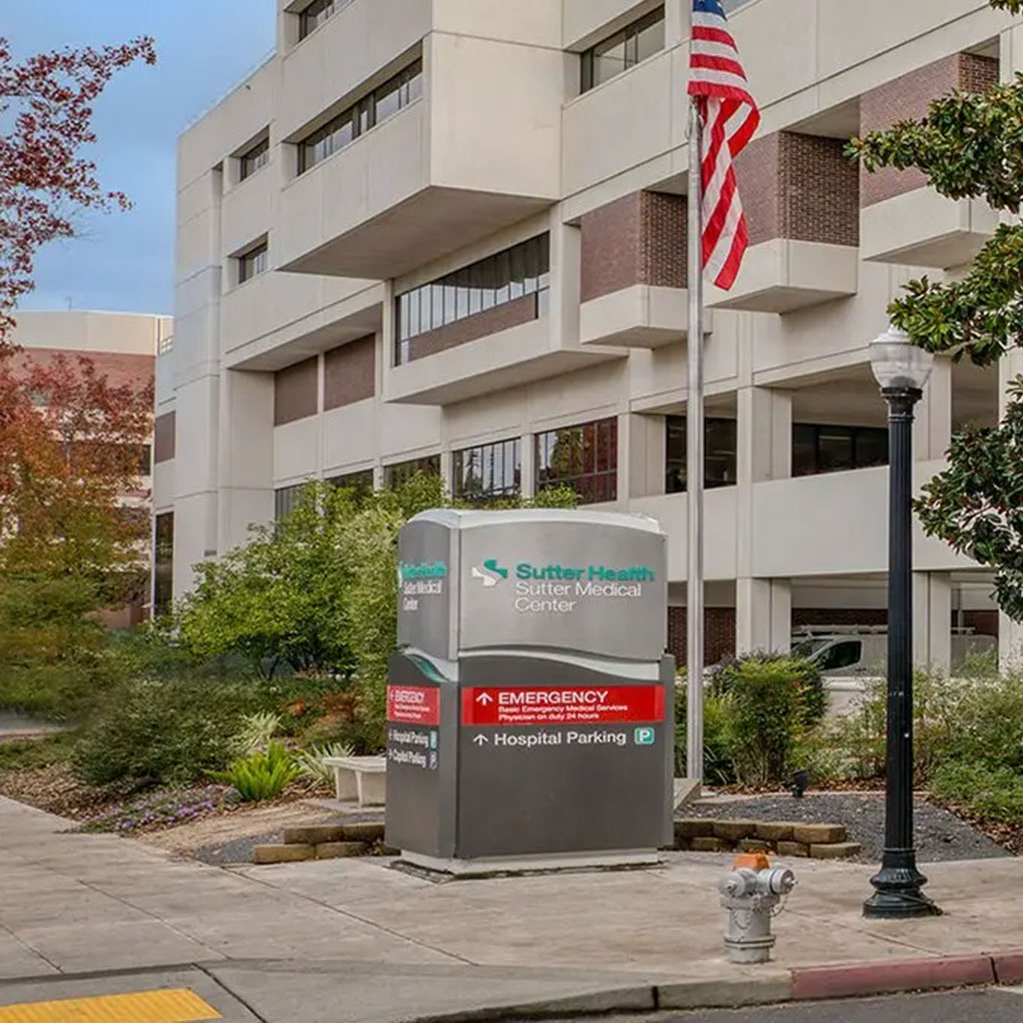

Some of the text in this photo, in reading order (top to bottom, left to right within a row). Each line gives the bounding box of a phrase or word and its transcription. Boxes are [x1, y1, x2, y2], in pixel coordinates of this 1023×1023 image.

[515, 564, 655, 582] Sutter Health
[515, 582, 642, 597] Sutter Medical
[514, 597, 577, 613] Center
[498, 691, 608, 704] EMERGENCY
[521, 705, 564, 714] Emergency
[566, 704, 595, 712] Medical
[597, 704, 628, 712] Services
[498, 713, 536, 722] Physician
[549, 712, 565, 721] duty
[566, 712, 576, 720] 24
[577, 712, 600, 720] hours
[494, 731, 562, 747] Hospital
[566, 731, 627, 746] Parking
